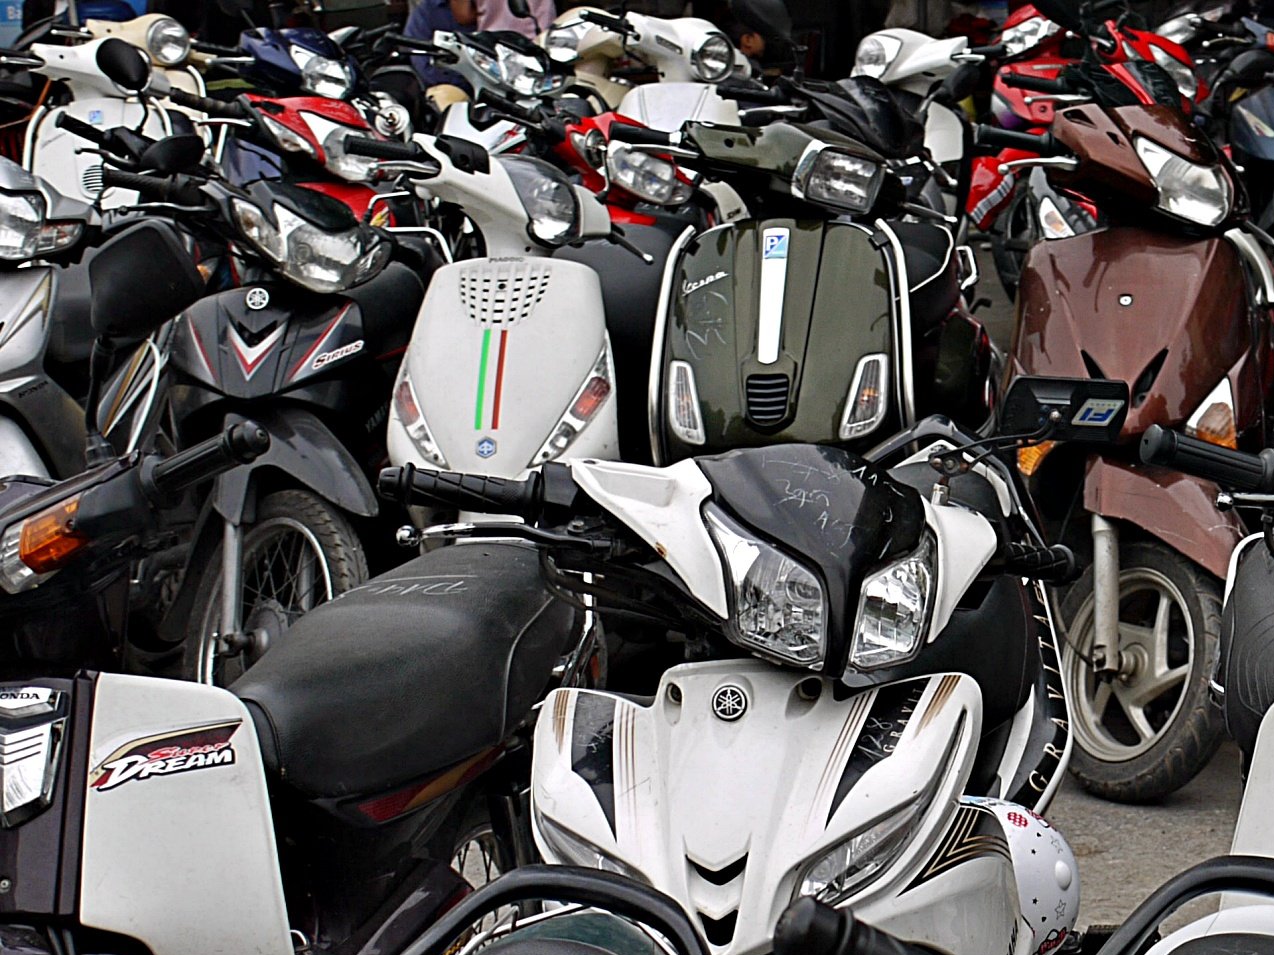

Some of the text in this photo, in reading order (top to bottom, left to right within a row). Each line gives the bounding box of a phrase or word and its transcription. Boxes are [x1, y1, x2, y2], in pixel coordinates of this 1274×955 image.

[682, 271, 730, 297] Vespa
[314, 341, 362, 369] SIRIUS
[99, 748, 235, 792] DREAM
